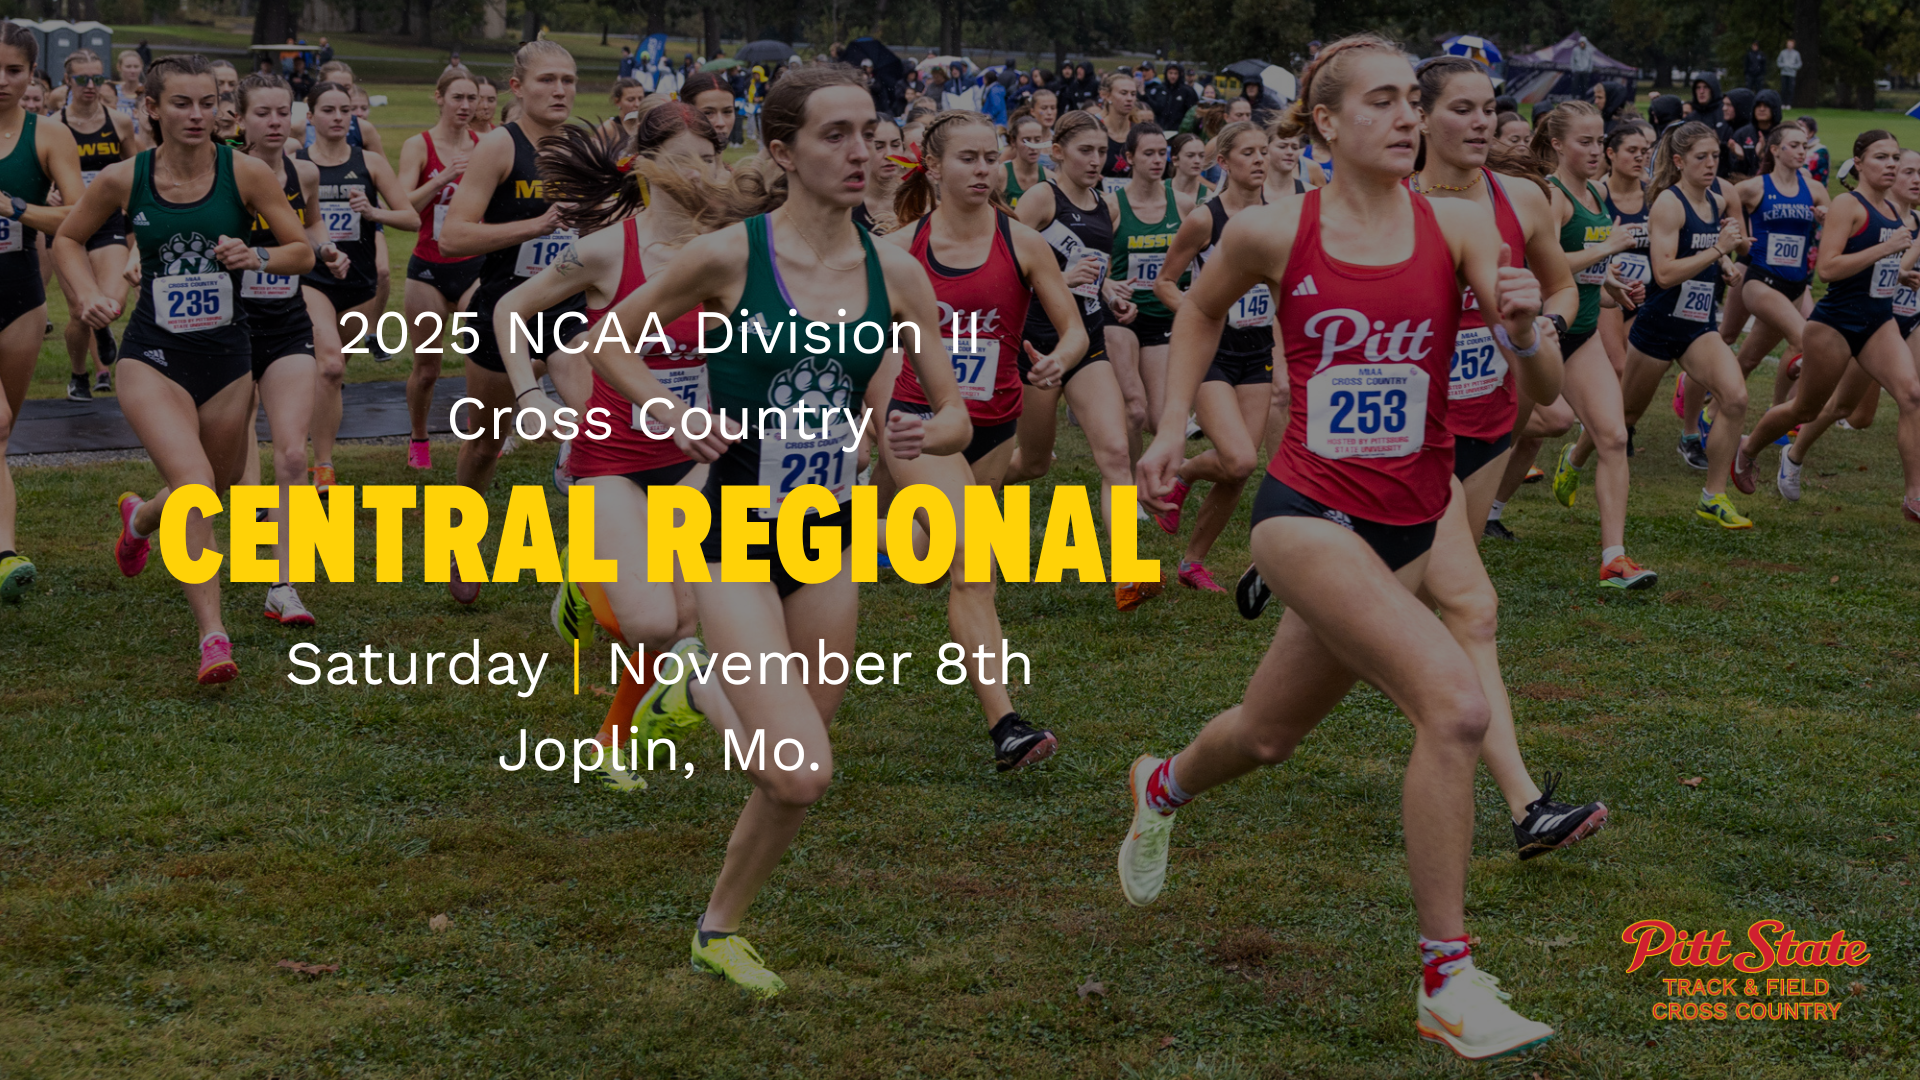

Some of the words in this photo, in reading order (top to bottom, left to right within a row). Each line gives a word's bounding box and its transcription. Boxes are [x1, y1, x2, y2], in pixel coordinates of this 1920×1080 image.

[77, 142, 120, 156] WSU
[1763, 209, 1814, 222] KEARNE
[1774, 243, 1799, 258] 200
[1620, 261, 1645, 279] 277
[168, 288, 219, 318] 235
[1238, 294, 1269, 318] 145
[1684, 291, 1711, 311] 280
[1304, 308, 1434, 374] Pitt
[951, 355, 986, 384] 57
[1358, 368, 1382, 376] MIAA
[1449, 345, 1496, 381] 252
[1332, 378, 1362, 386] CROSS
[1366, 377, 1408, 386] COUNTRY
[1329, 389, 1407, 434] 253
[780, 447, 845, 493] 231
